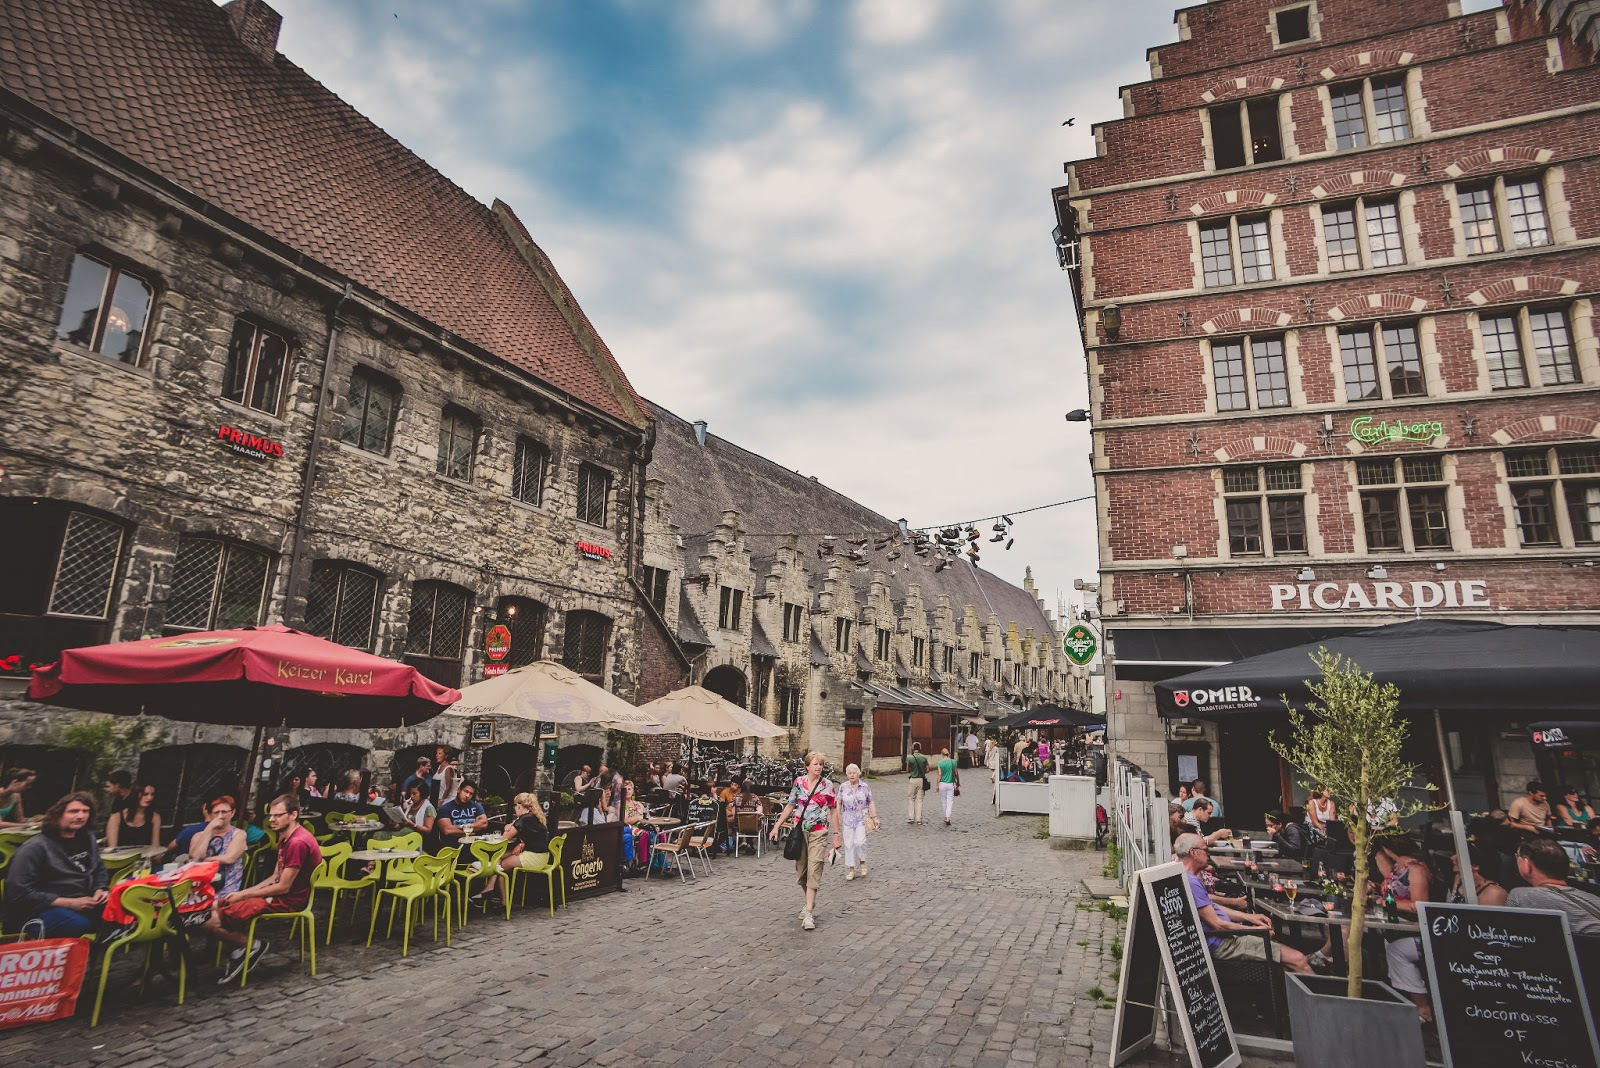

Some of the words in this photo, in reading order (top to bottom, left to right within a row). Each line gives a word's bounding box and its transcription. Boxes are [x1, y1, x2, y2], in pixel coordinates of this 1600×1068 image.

[218, 425, 283, 457] PRIMUS
[1351, 416, 1443, 445] Carlsberg
[233, 445, 267, 459] HAACHT
[577, 541, 611, 558] PRIMUS
[1269, 580, 1490, 610] PICARDIE
[277, 660, 327, 681] Keizer
[335, 668, 373, 686] Karel
[1191, 686, 1261, 705] OMER.
[1198, 703, 1236, 712] TRADITIONAL
[451, 807, 477, 818] CALF
[571, 857, 603, 879] Tongerlo
[1160, 895, 1183, 915] Strop
[0, 946, 71, 974] ROTE
[0, 966, 65, 988] ENING
